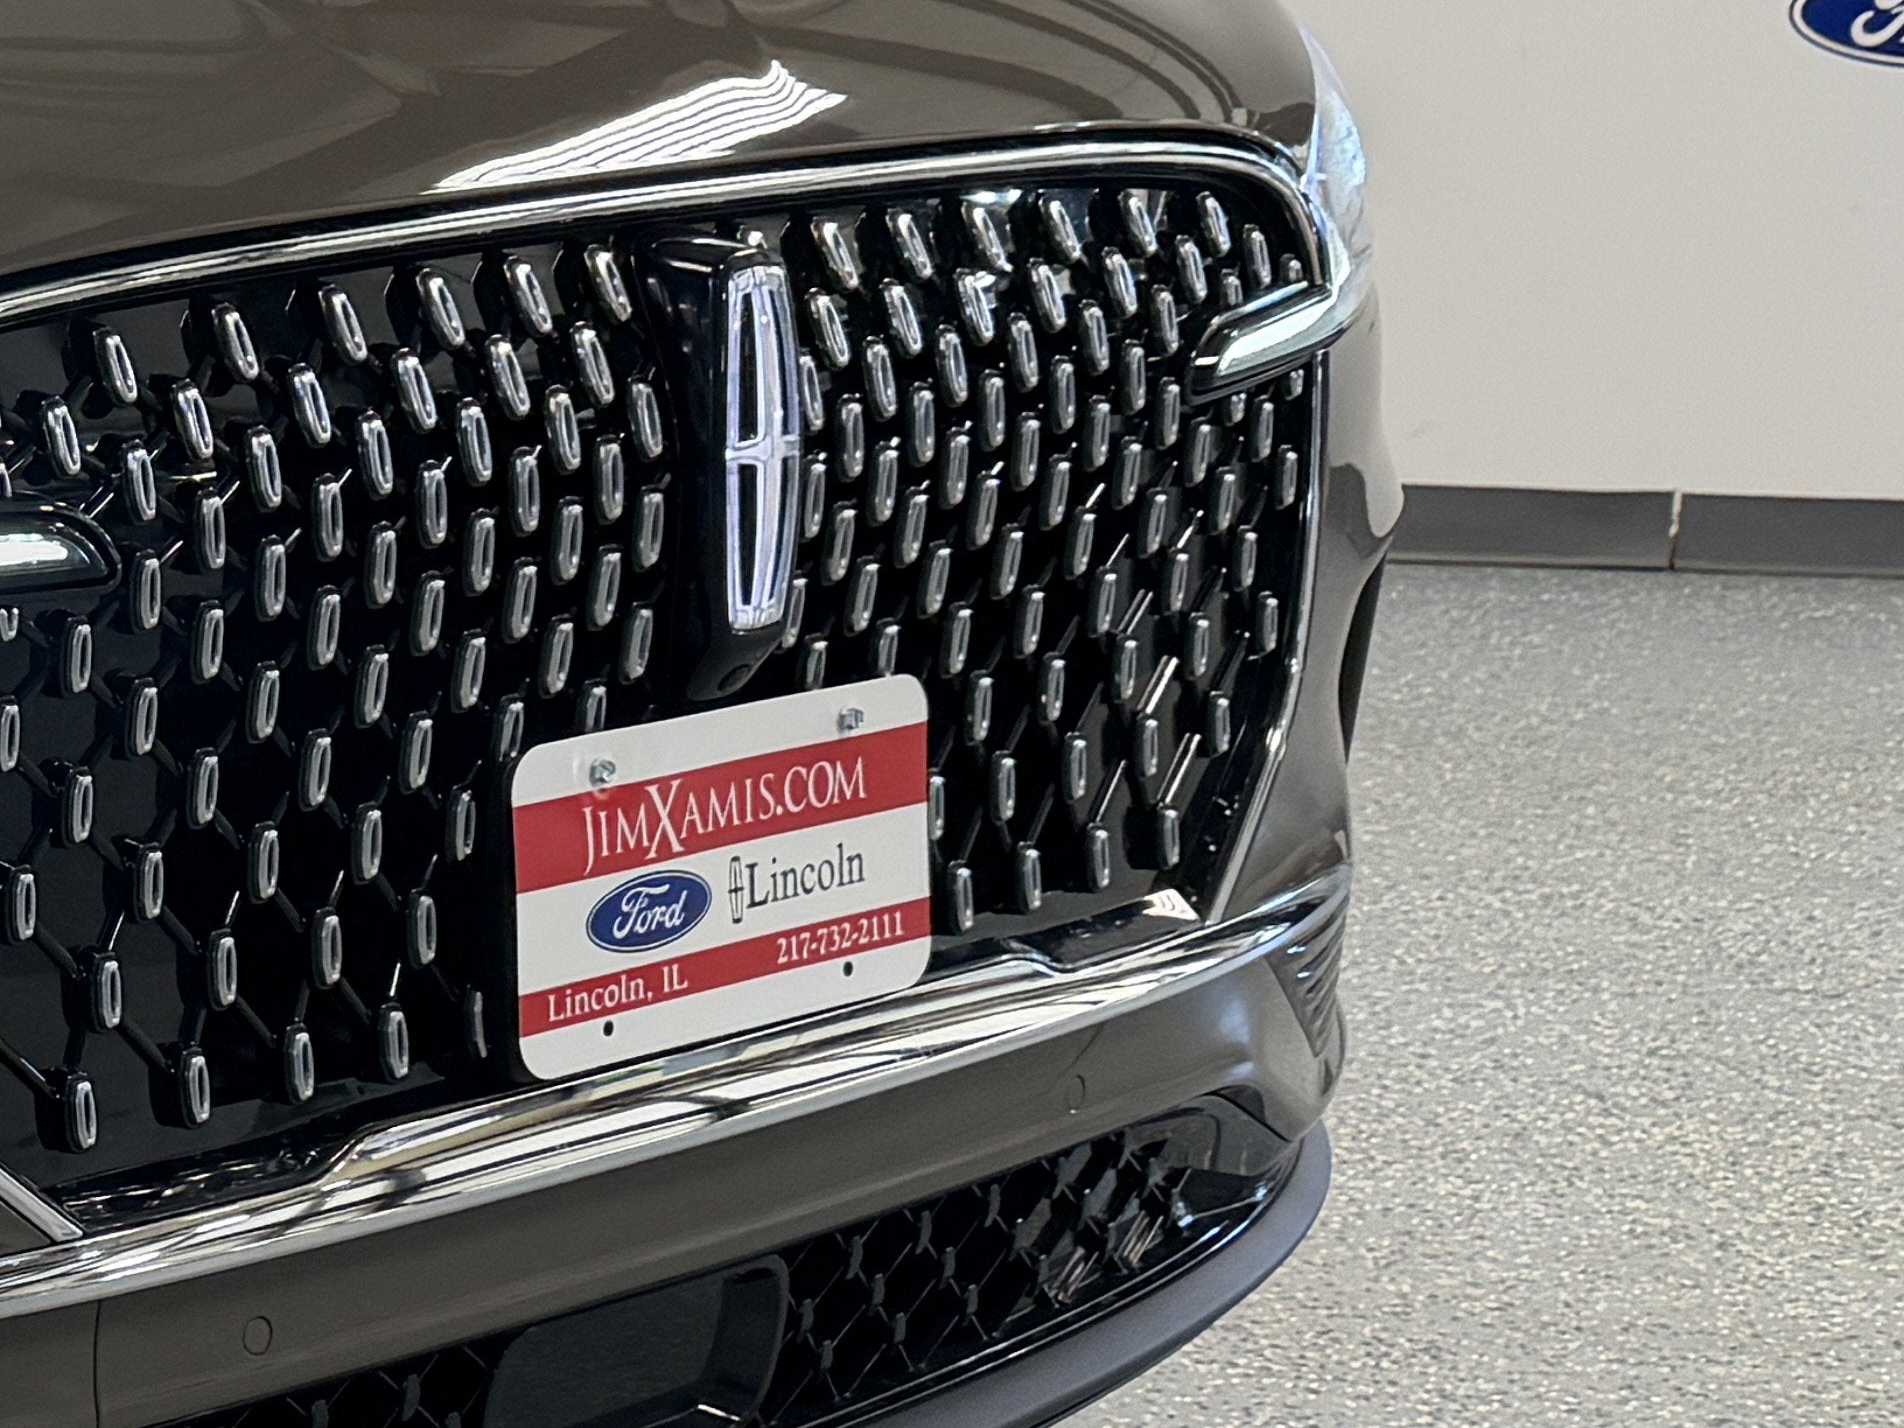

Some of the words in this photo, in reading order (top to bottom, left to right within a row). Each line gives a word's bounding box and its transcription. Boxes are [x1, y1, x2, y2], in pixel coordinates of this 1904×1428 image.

[744, 842, 865, 910] Lincoln
[612, 884, 688, 939] Ford
[775, 911, 905, 965] 217-732-2111
[662, 963, 689, 993] IL
